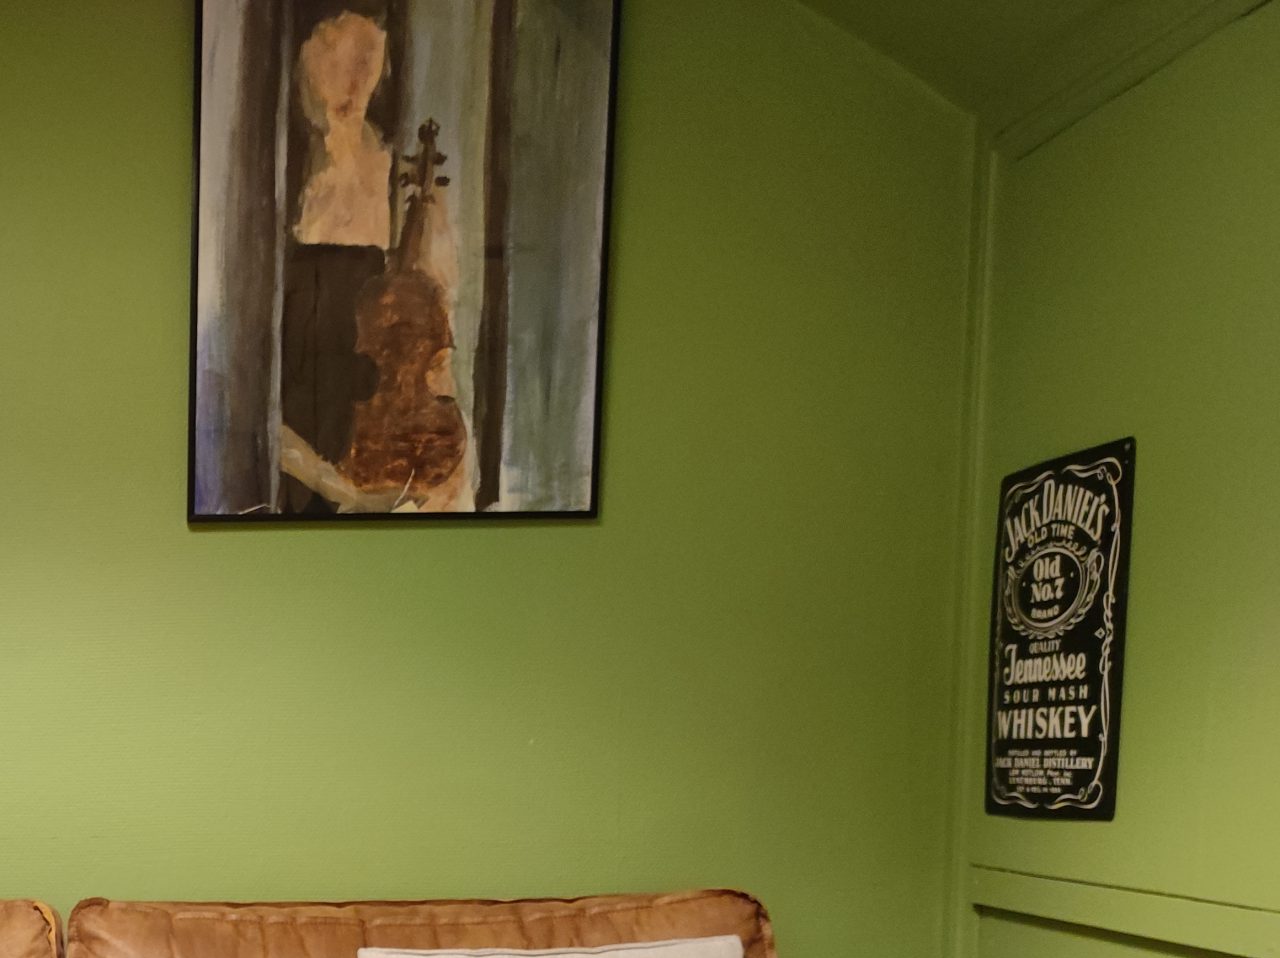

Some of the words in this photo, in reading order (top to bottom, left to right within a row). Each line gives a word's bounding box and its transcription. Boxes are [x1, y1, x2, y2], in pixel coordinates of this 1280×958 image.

[1005, 494, 1041, 563] JACK
[1043, 479, 1110, 542] DANIEL'S
[1027, 527, 1048, 547] OLD
[1051, 523, 1076, 540] TIME
[1033, 554, 1061, 581] Old
[1003, 643, 1086, 686] Tennessee
[1003, 688, 1040, 704] SOUR
[1048, 684, 1088, 701] MASH
[997, 705, 1097, 740] WHISKEY
[1043, 757, 1094, 770] DISTILLERY
